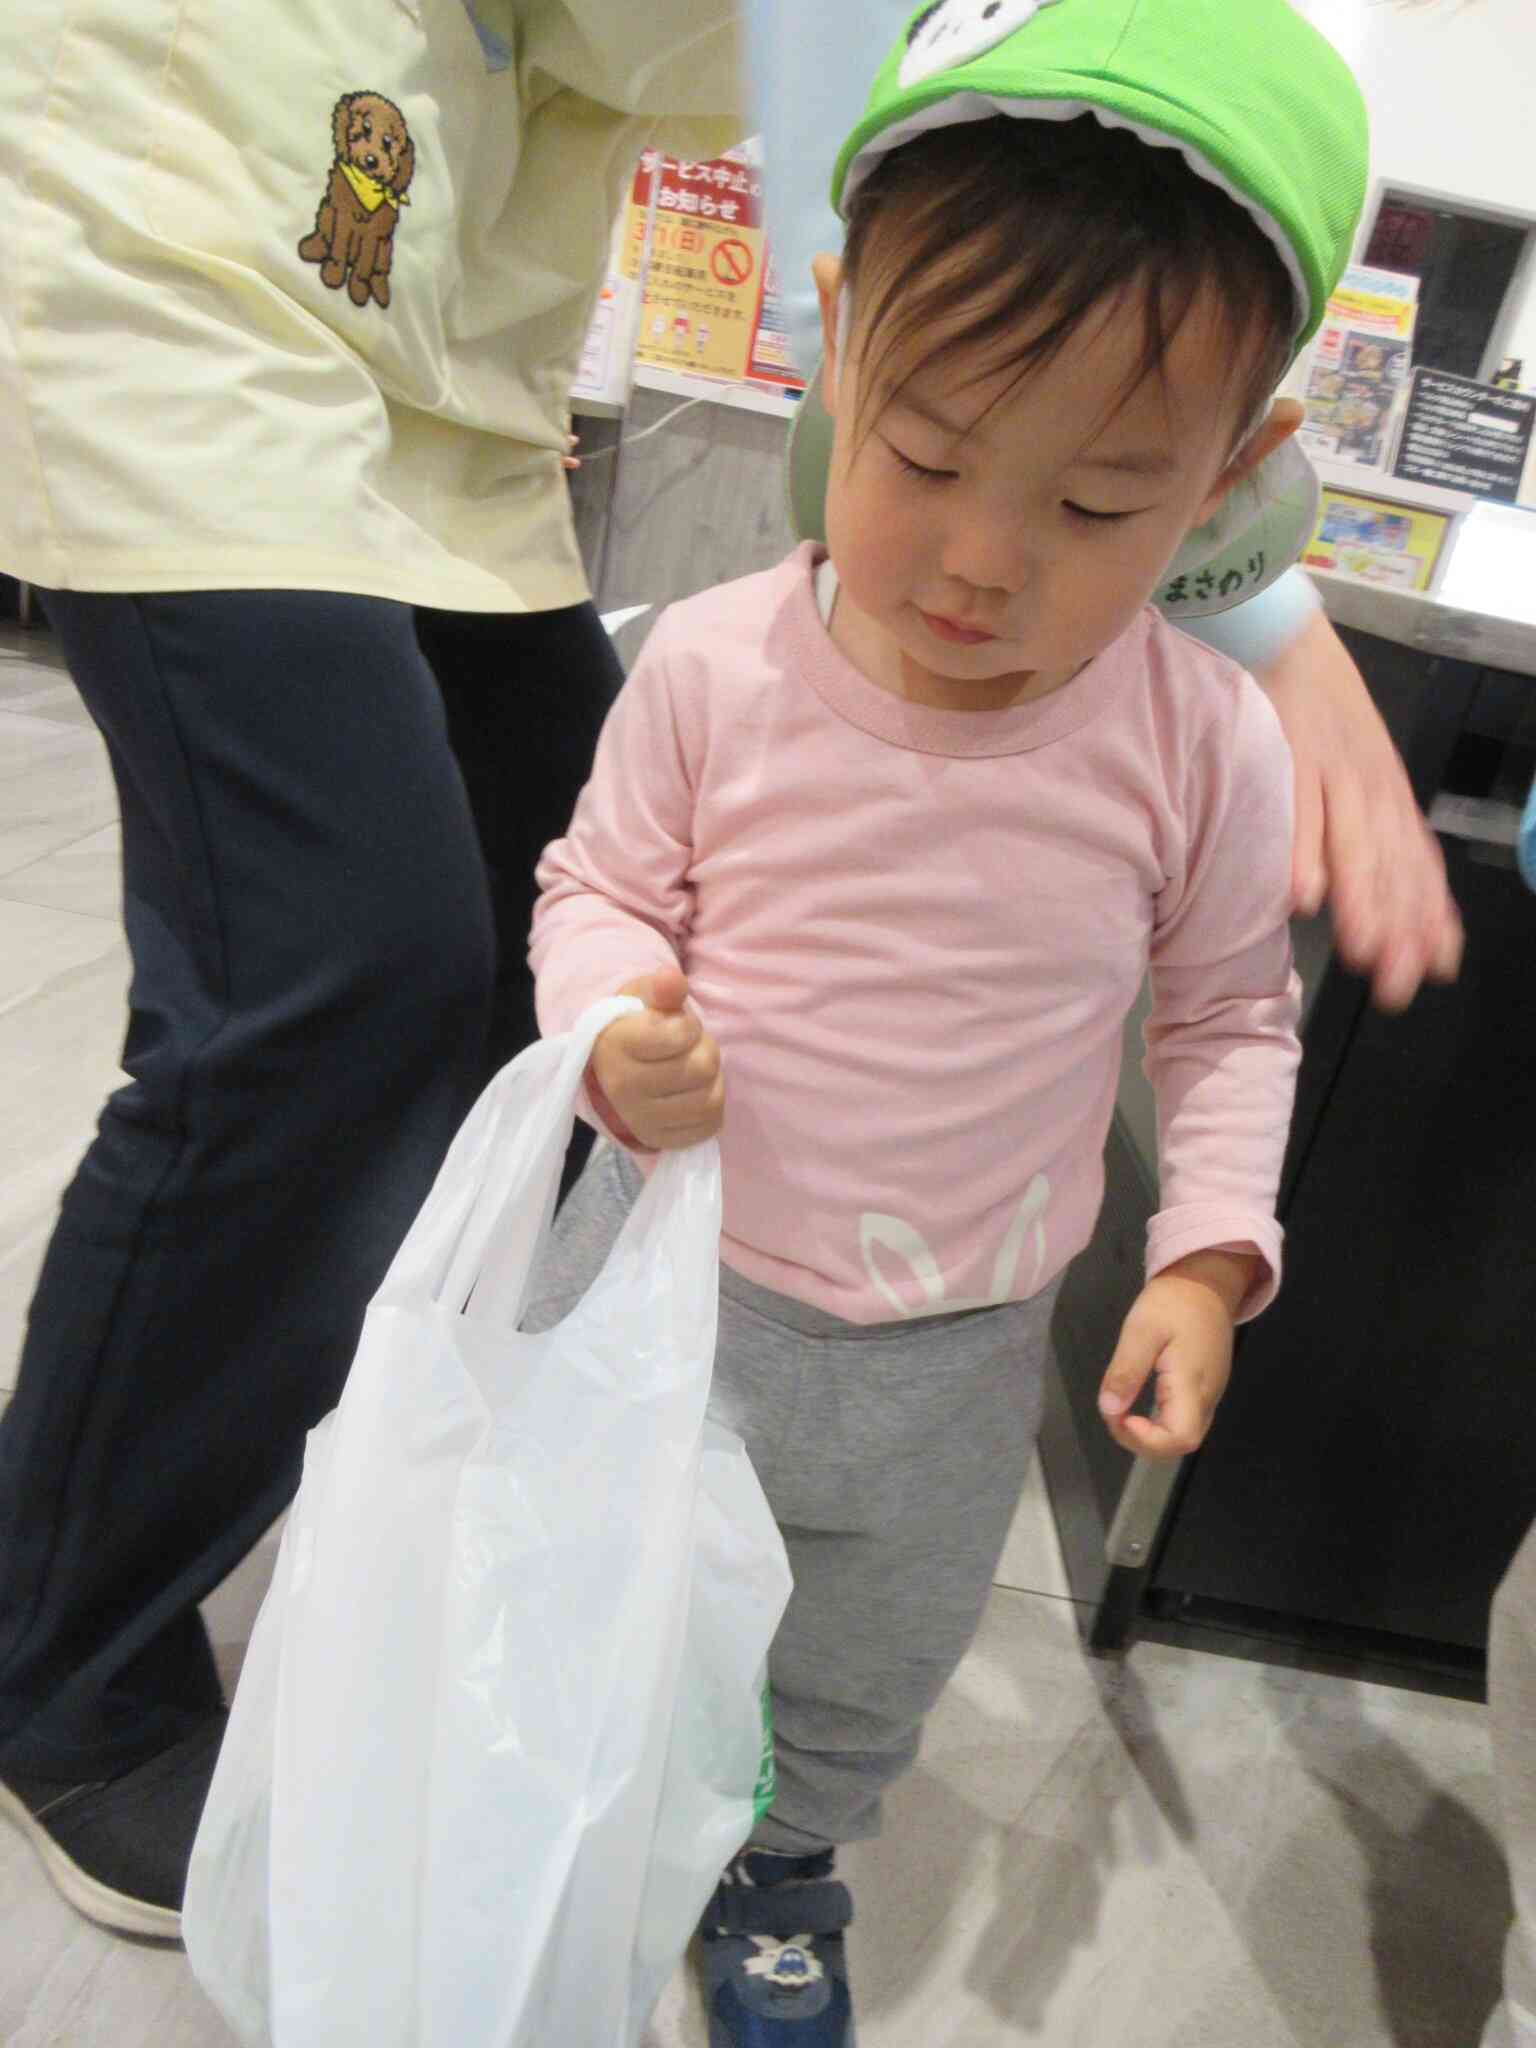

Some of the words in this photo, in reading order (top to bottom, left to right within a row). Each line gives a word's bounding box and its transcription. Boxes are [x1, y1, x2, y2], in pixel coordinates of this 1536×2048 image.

[658, 186, 740, 219] お知らせ
[1165, 551, 1264, 602] まさのり
